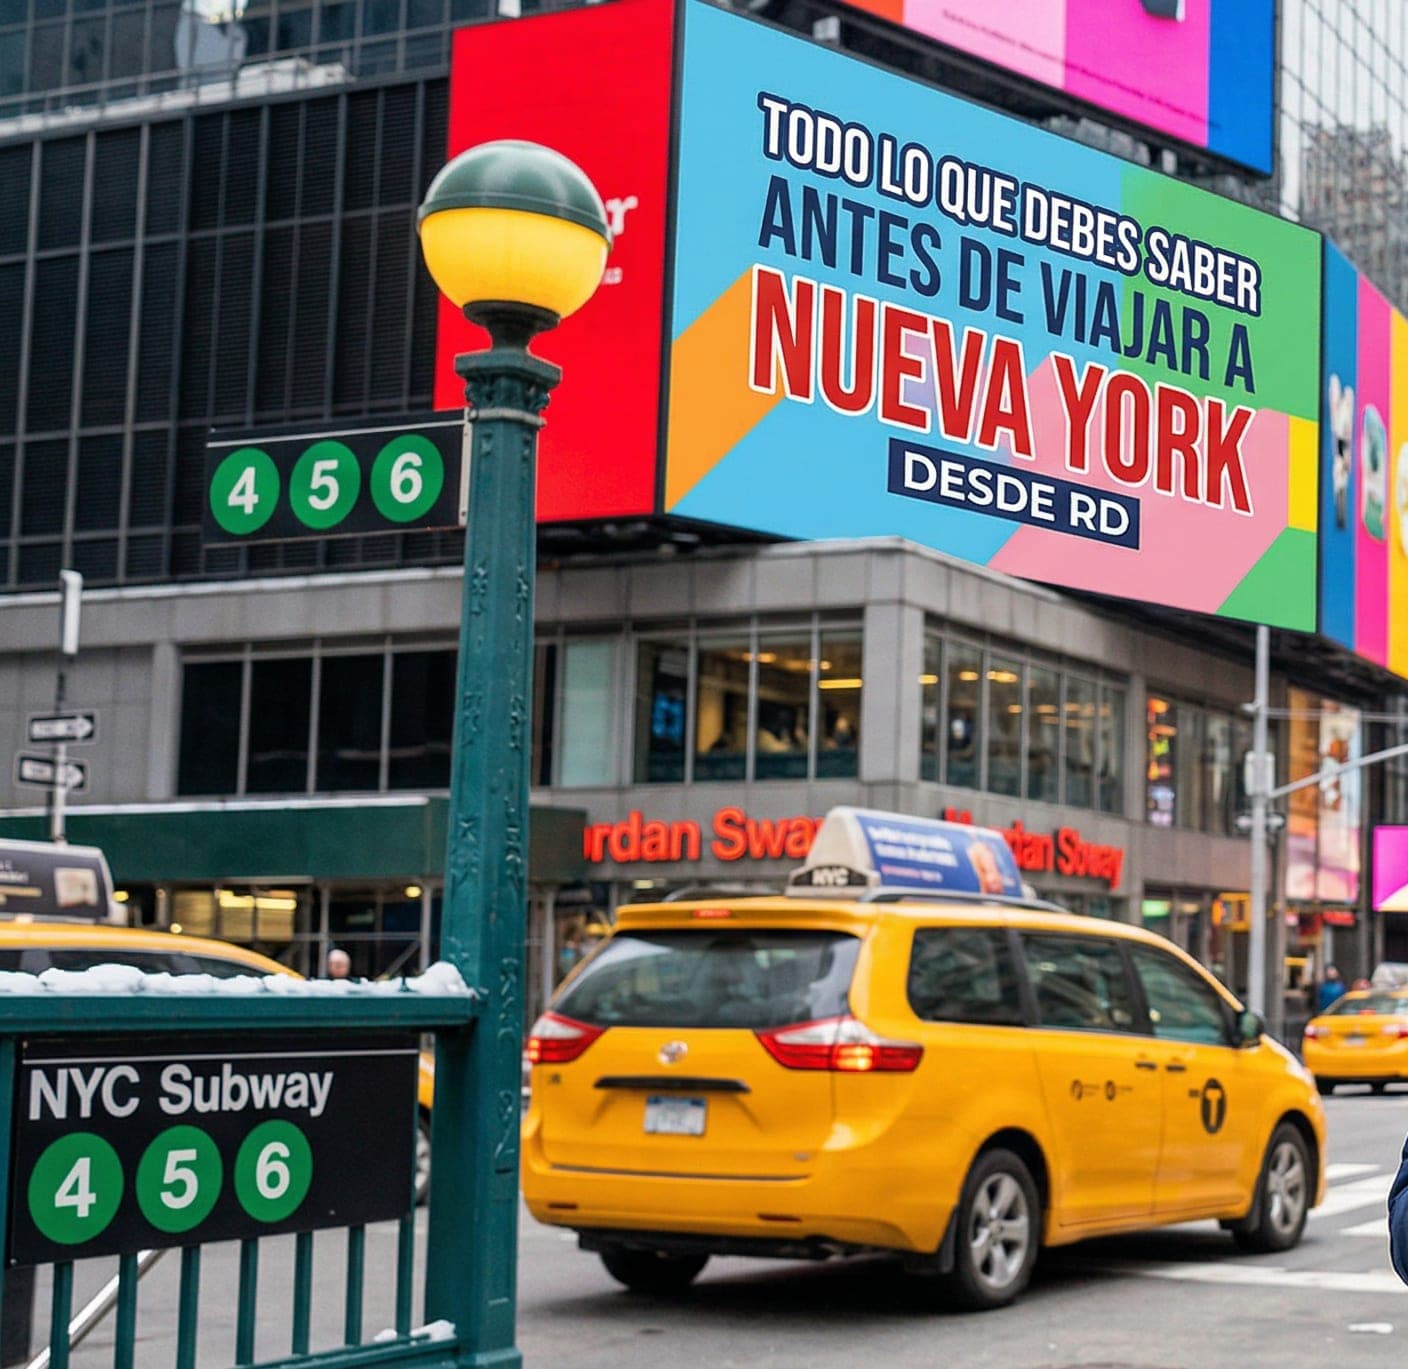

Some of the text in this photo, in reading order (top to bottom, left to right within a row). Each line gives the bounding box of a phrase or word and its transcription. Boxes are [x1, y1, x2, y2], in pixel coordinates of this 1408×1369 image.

[761, 95, 1261, 314] TODO LO QUE DEBES SABER
[759, 175, 1256, 394] ANTES DE VIAJAR A
[751, 266, 1255, 515] NUEVA YORK
[228, 452, 423, 514] 4 5 6
[903, 451, 1130, 536] DESDE RD
[28, 1062, 334, 1121] NYC Subway
[54, 1141, 291, 1218] 4 5 6
